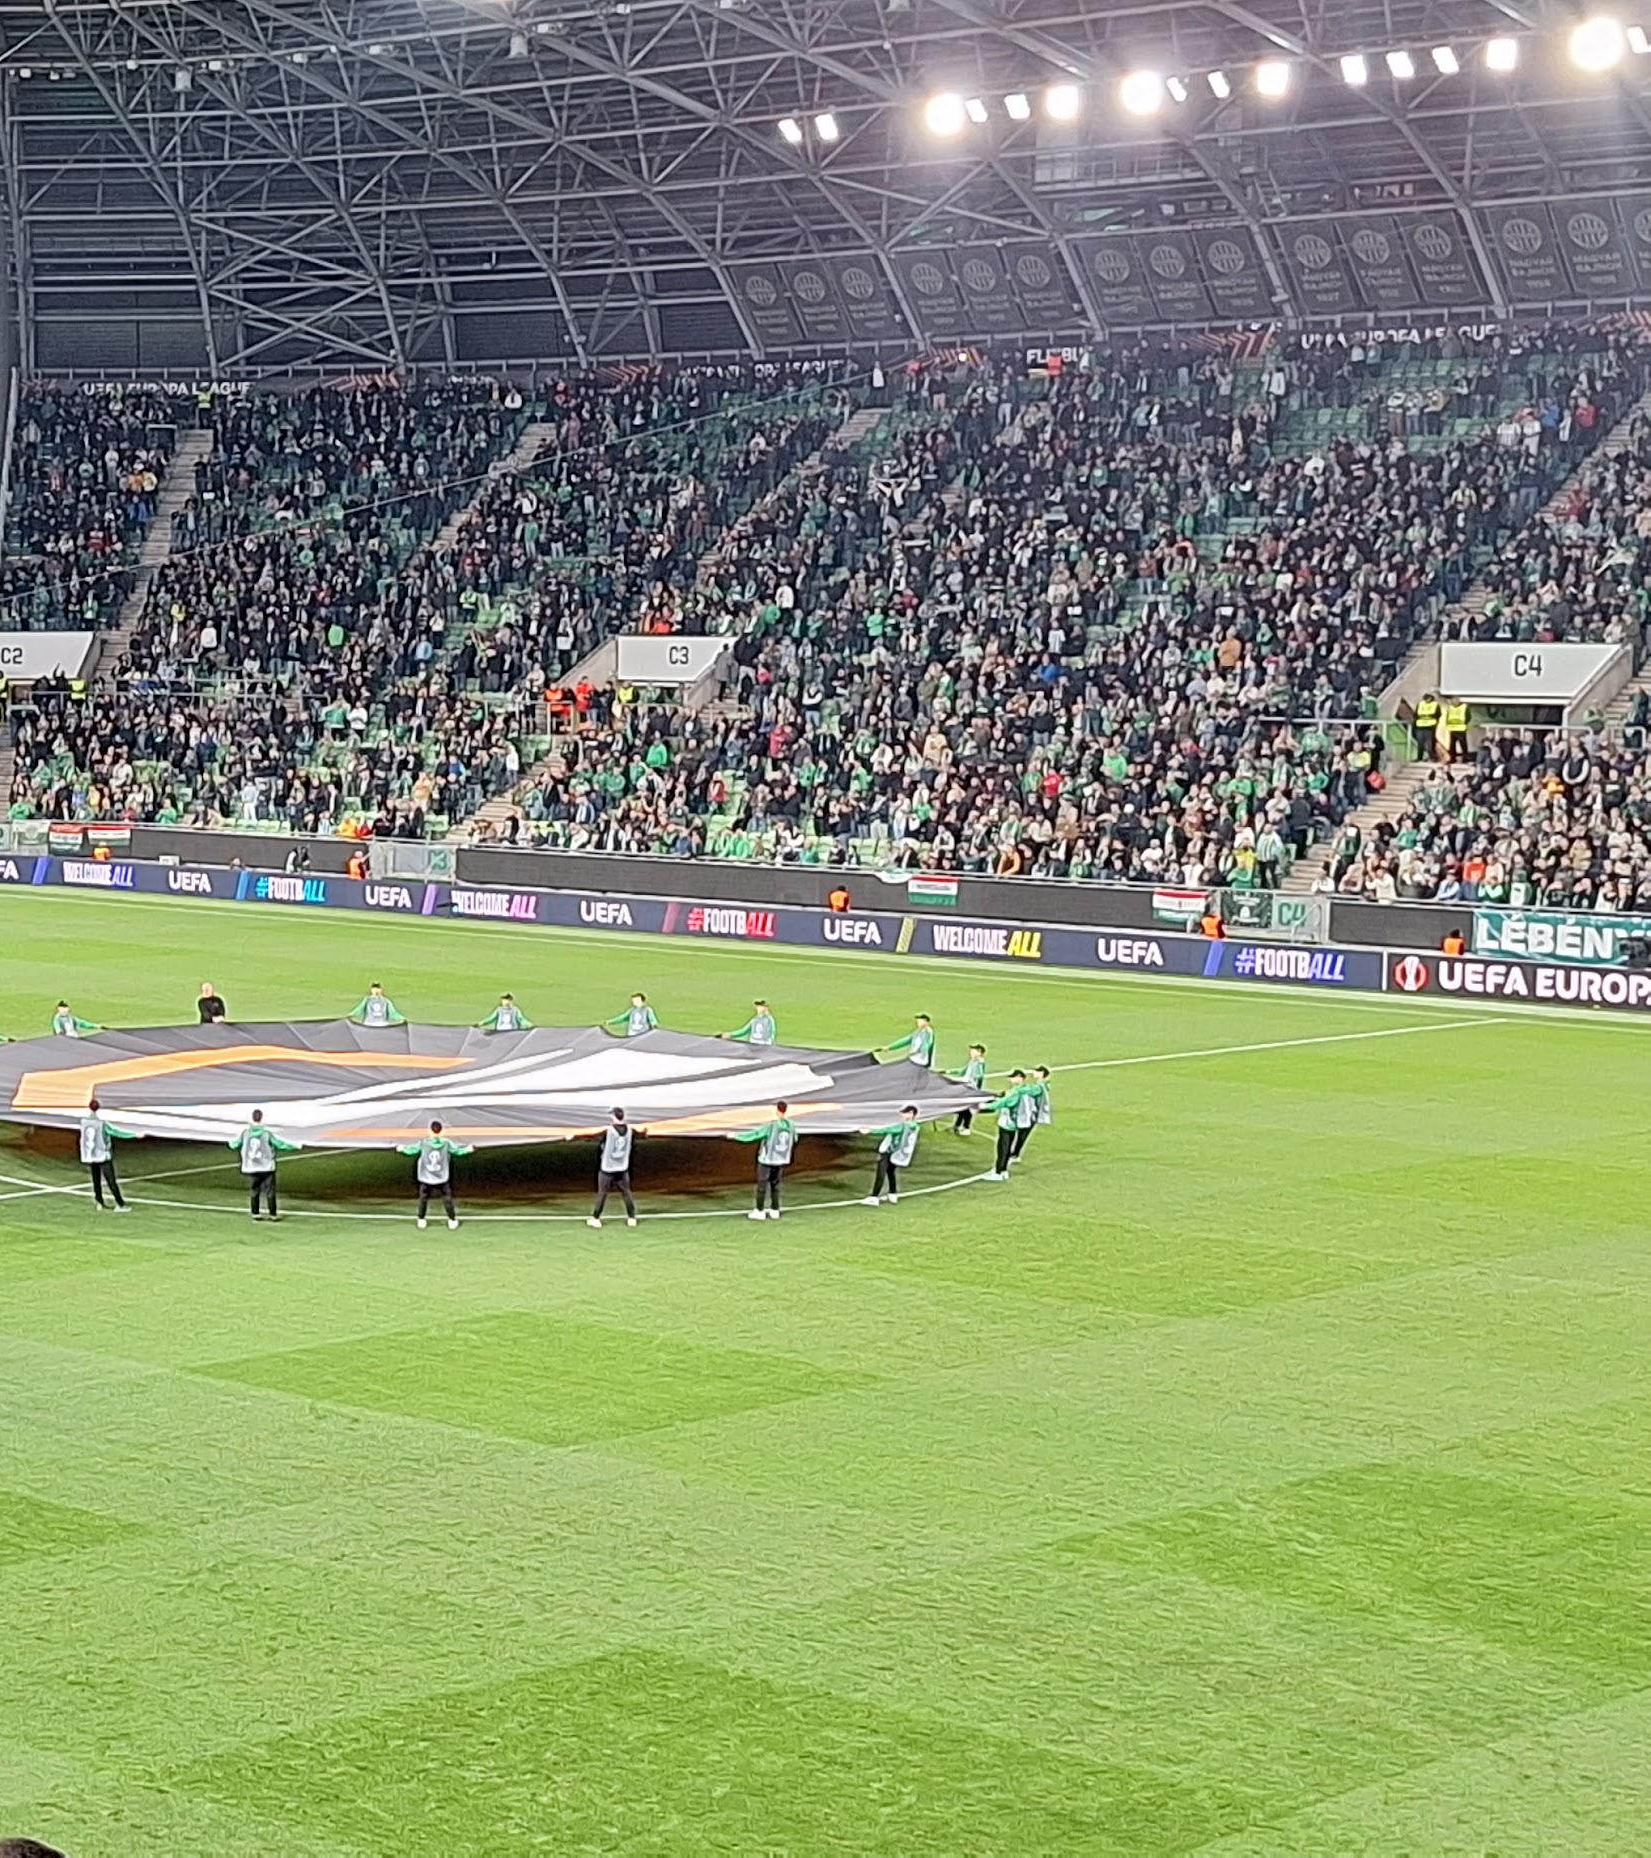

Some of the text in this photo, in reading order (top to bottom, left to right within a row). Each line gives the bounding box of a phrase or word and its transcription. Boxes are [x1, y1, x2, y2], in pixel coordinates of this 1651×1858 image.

[669, 645, 690, 665] C3
[1514, 654, 1543, 677] C4
[169, 870, 213, 893] UEFA
[255, 876, 326, 902] #FOOTBALL
[366, 885, 412, 909] UEFA
[451, 890, 537, 919] WELCOME ALL
[580, 900, 633, 926] UEFA
[687, 908, 777, 937] #FOOTBALL
[824, 918, 882, 945] UEFA
[934, 924, 1042, 958] WELCOME ALL
[1098, 938, 1164, 966] UEFA
[1235, 947, 1345, 981] #FOOTBALL
[1438, 961, 1651, 1006] UEFA EUROP
